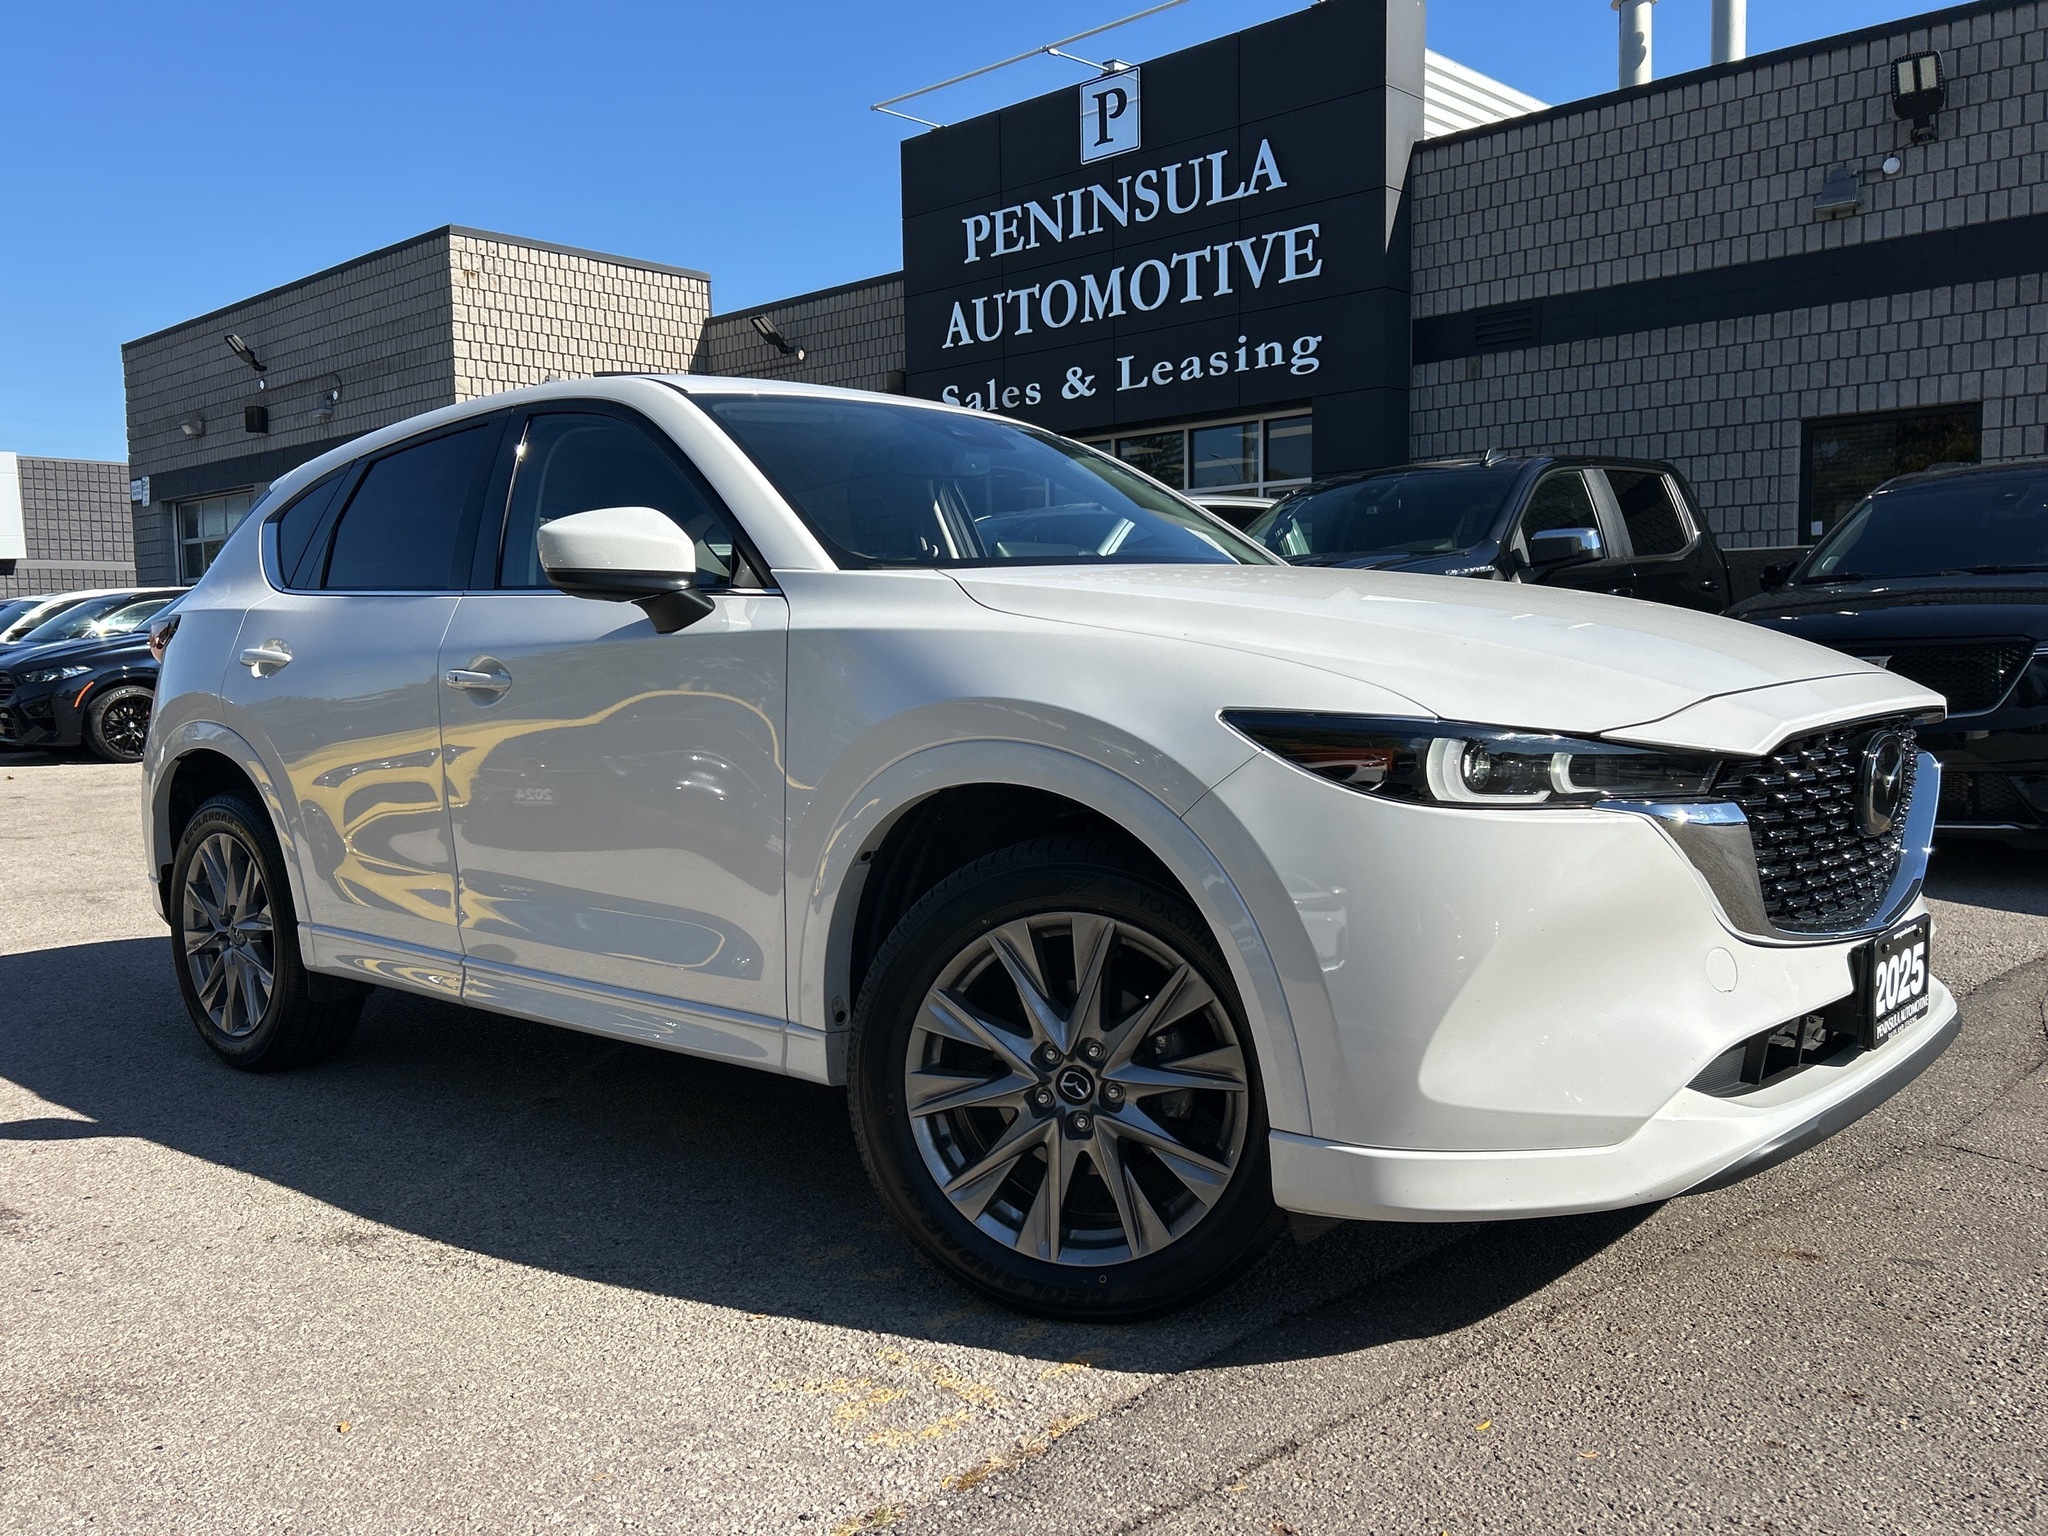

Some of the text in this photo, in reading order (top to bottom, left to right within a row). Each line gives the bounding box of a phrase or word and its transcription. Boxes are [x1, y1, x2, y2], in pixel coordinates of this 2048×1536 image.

[1092, 87, 1127, 147] P
[962, 138, 1288, 264] PENINSULA
[941, 223, 1323, 349] AUTOMOTIVE
[941, 335, 1323, 412] Sales & Leasing
[1875, 941, 1925, 1018] 2025
